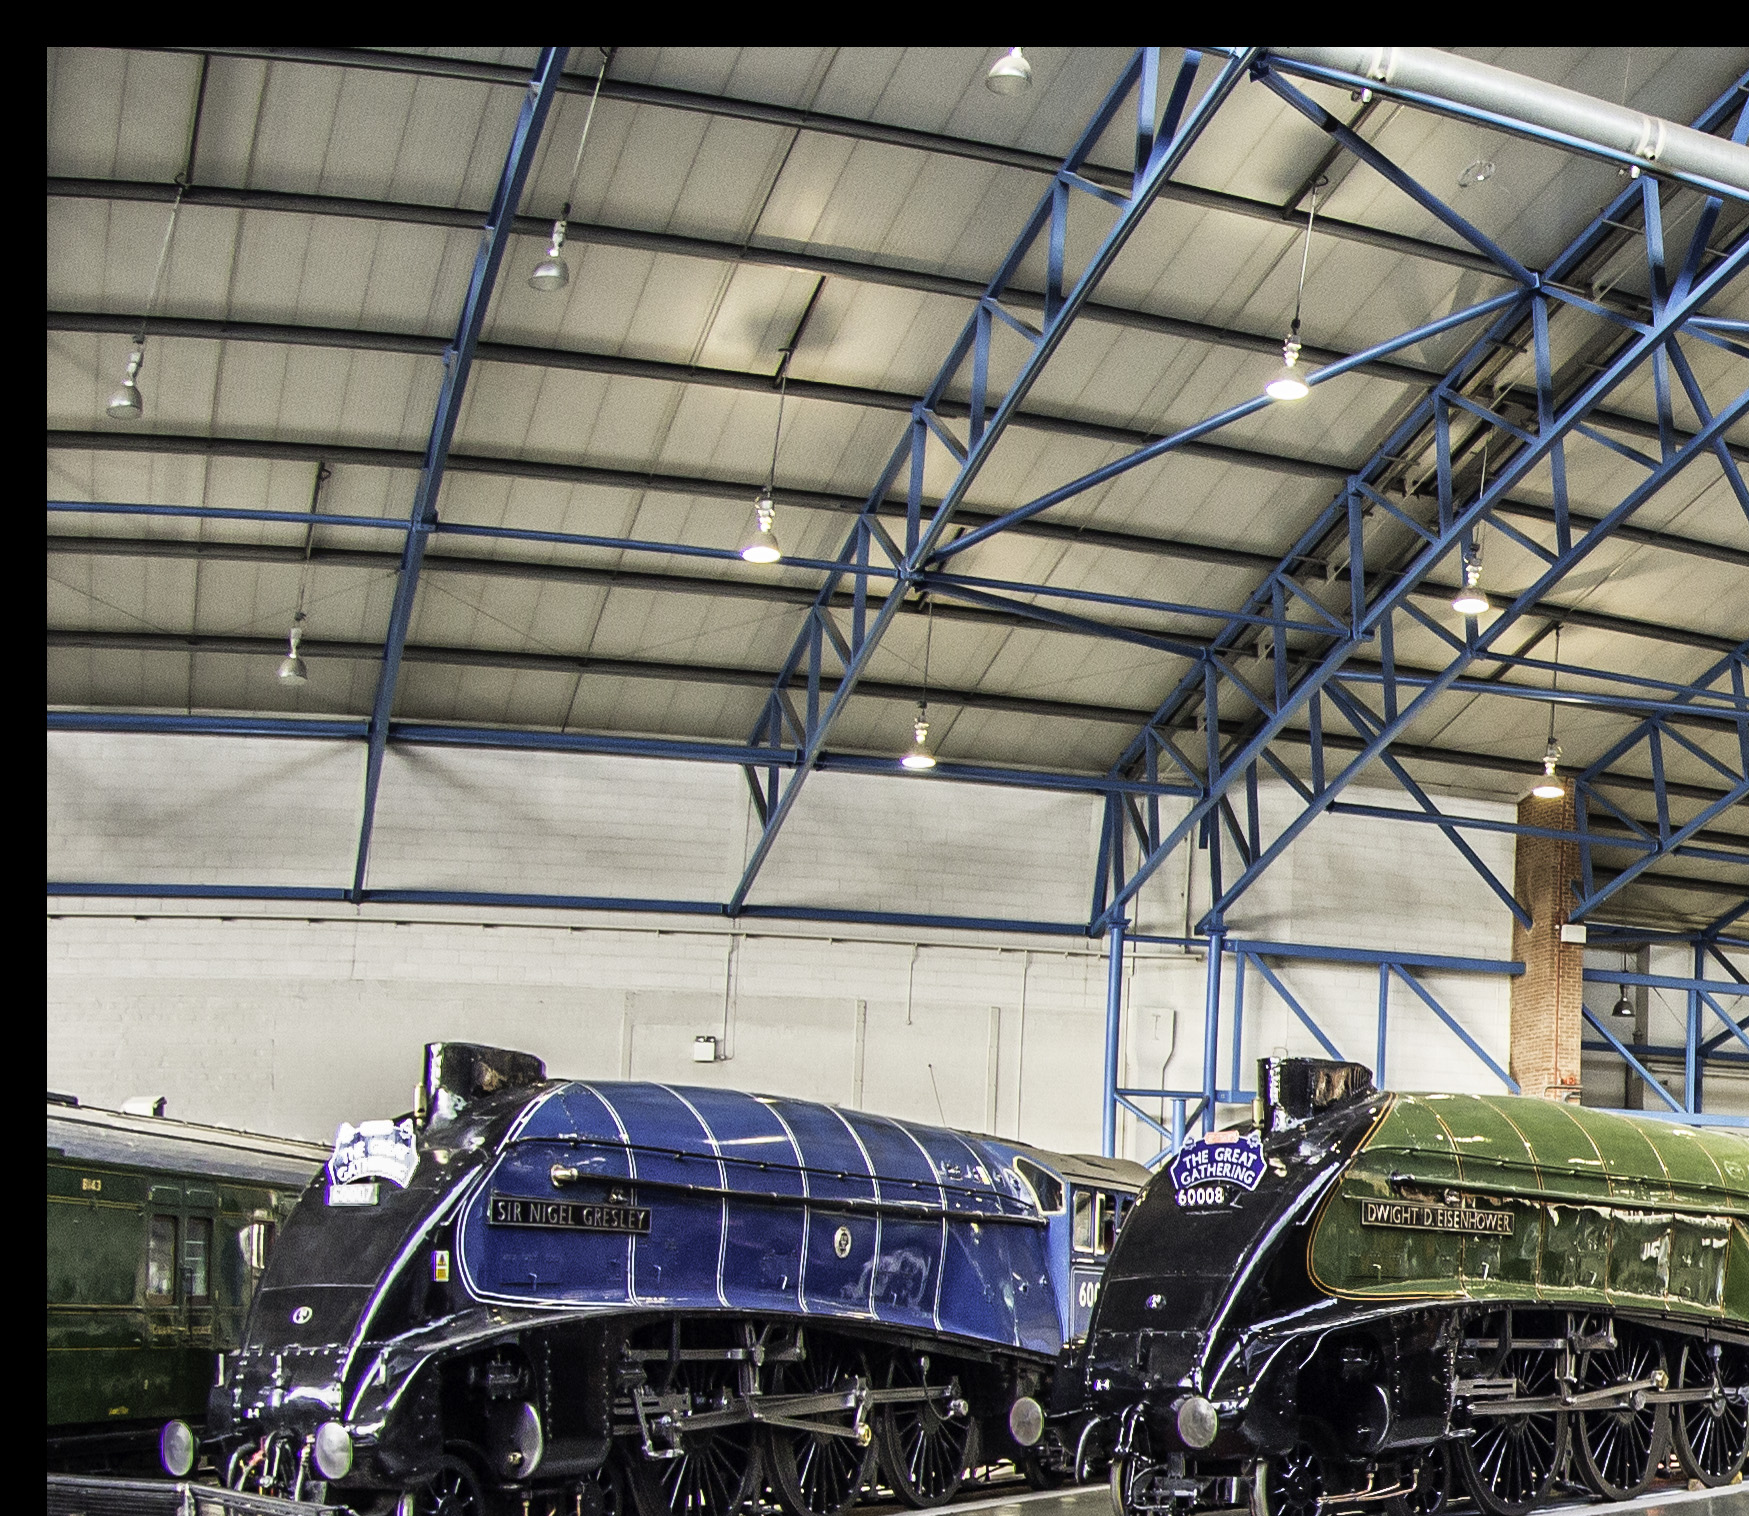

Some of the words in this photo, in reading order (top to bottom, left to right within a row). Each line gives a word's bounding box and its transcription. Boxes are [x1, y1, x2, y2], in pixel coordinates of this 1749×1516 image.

[1183, 1150, 1209, 1169] THE
[1215, 1148, 1257, 1168] GREAT
[1180, 1163, 1256, 1185] GATHERING
[1178, 1187, 1225, 1206] 60008
[498, 1202, 522, 1222] SIR
[529, 1202, 575, 1225] NIGEL
[583, 1206, 646, 1230] GRESLEY
[1367, 1203, 1418, 1225] DWIGHT
[1437, 1209, 1511, 1233] EISENHOWER
